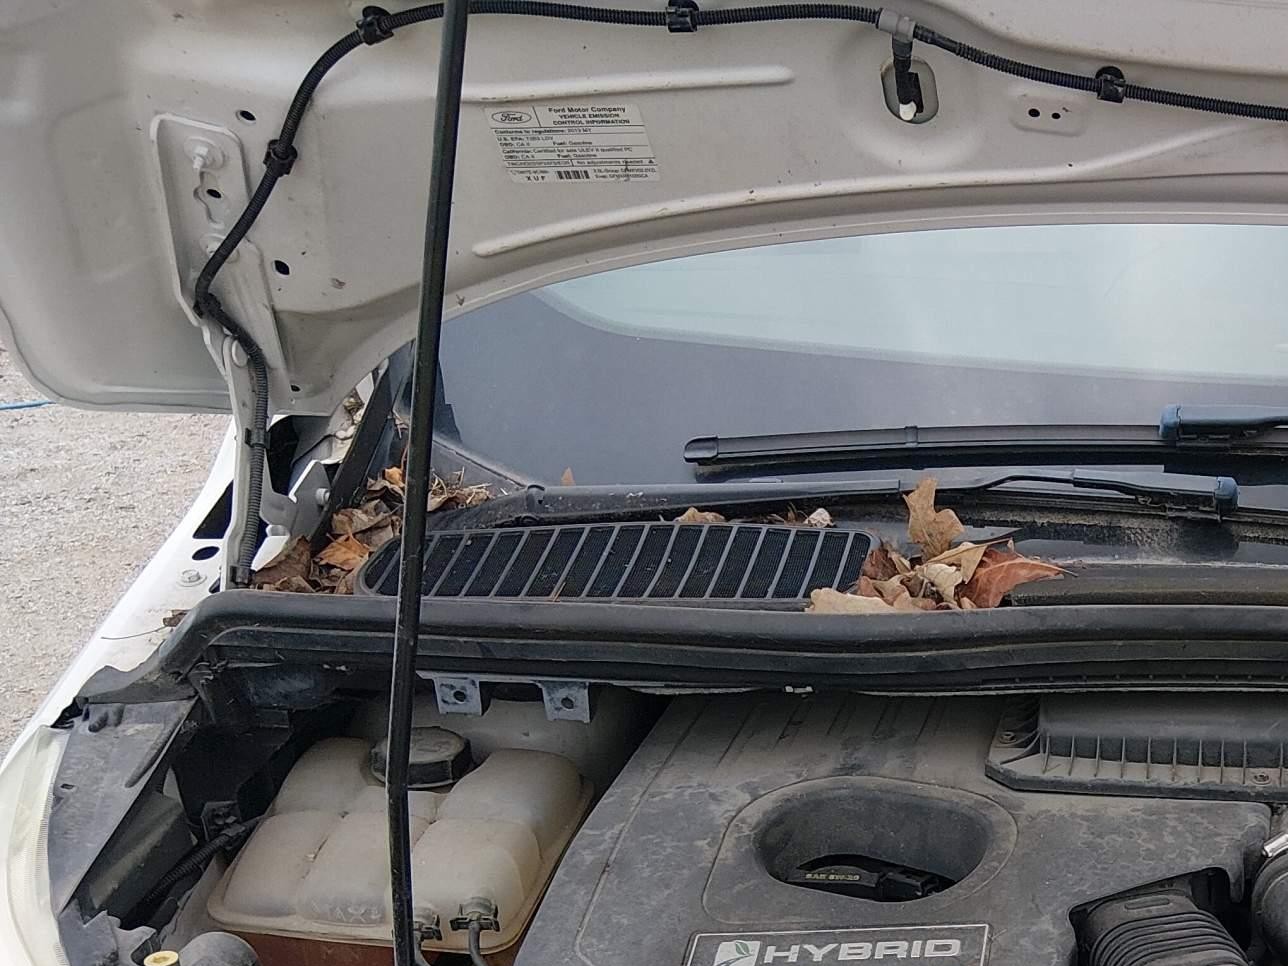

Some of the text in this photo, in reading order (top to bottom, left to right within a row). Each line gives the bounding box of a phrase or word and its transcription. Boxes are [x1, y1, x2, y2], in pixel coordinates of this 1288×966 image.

[590, 106, 626, 114] Company
[500, 112, 523, 122] Ford
[763, 938, 962, 964] HYBRID
